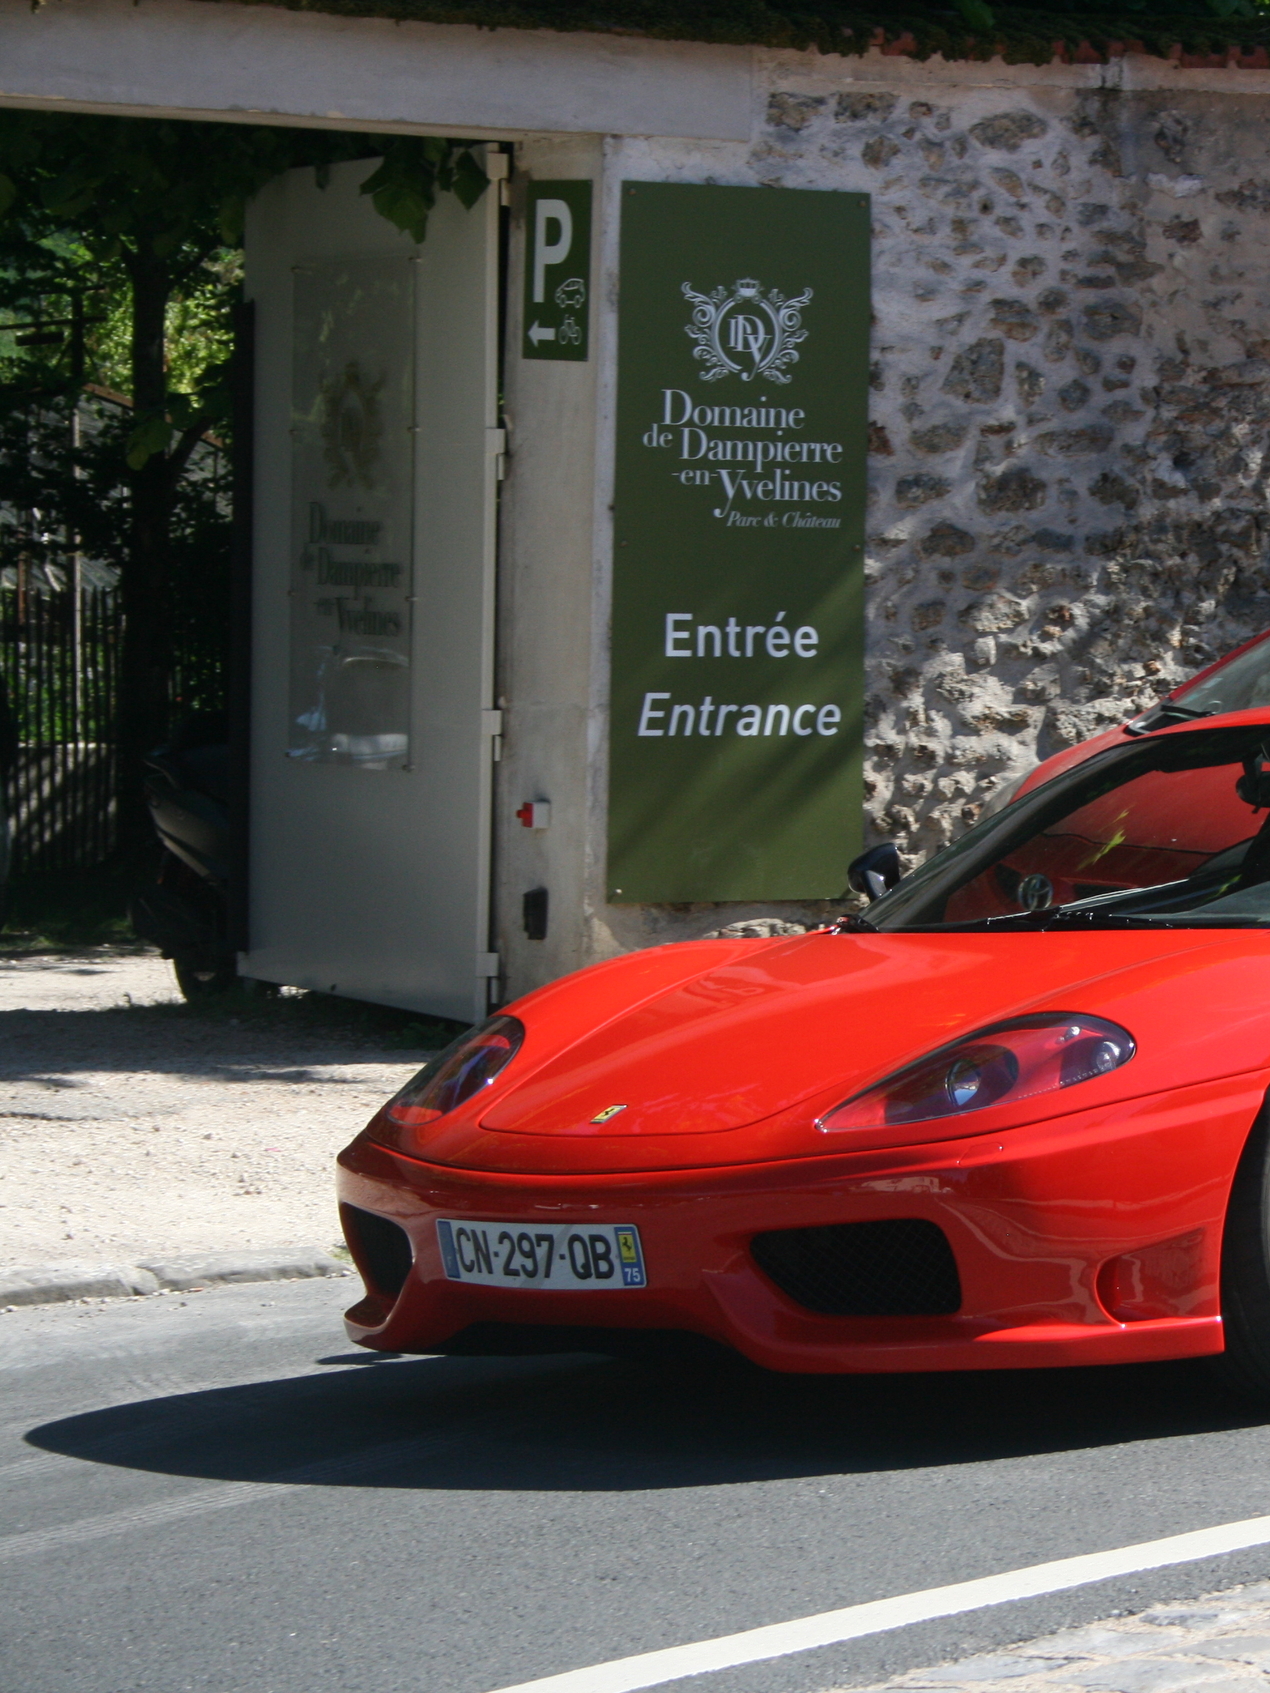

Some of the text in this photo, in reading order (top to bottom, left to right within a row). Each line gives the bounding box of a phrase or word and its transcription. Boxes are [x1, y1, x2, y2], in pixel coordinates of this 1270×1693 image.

[533, 199, 574, 303] P
[660, 389, 805, 430] Domaine
[642, 424, 844, 474] de Dampierre
[726, 510, 842, 528] Parc & Château
[664, 611, 820, 658] Entrée
[637, 692, 842, 737] Entrance
[456, 1226, 615, 1280] CN-297-QB
[624, 1267, 641, 1282] 75
